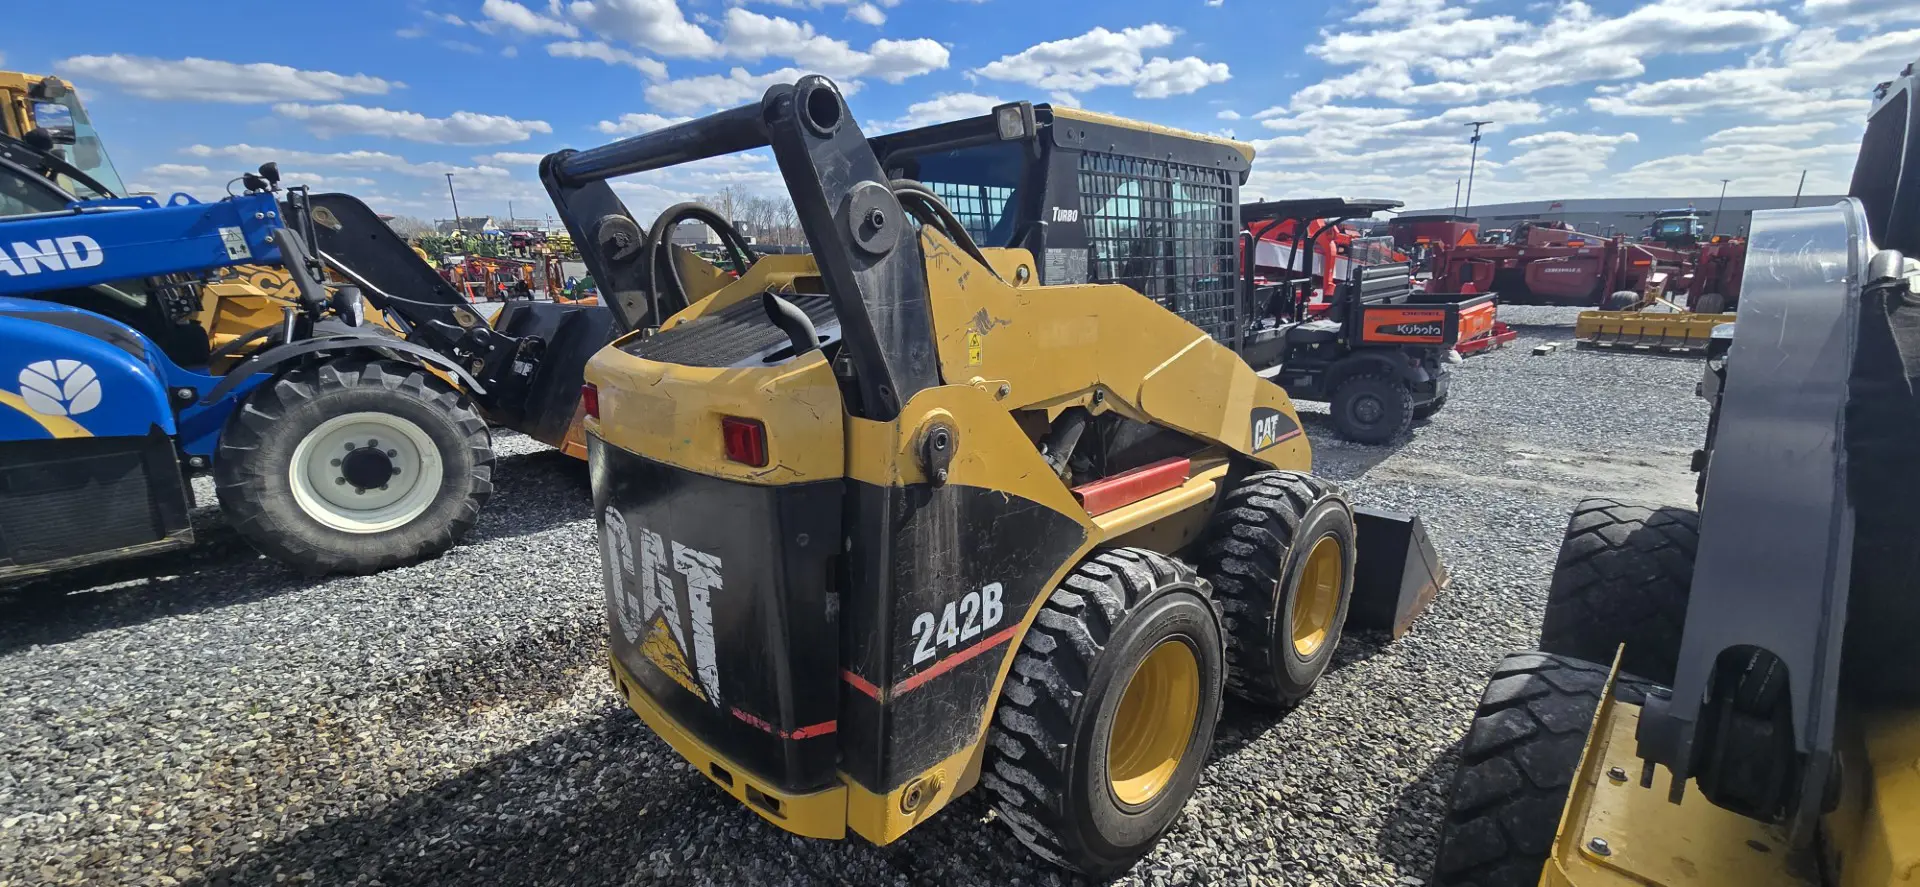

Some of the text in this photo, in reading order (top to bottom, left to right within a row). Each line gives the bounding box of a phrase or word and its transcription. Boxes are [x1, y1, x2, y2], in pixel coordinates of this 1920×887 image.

[1052, 206, 1078, 223] TURBO
[1397, 323, 1441, 335] Kubota
[1254, 414, 1279, 450] CAT
[605, 505, 723, 709] CAT
[911, 581, 1004, 666] 242B
